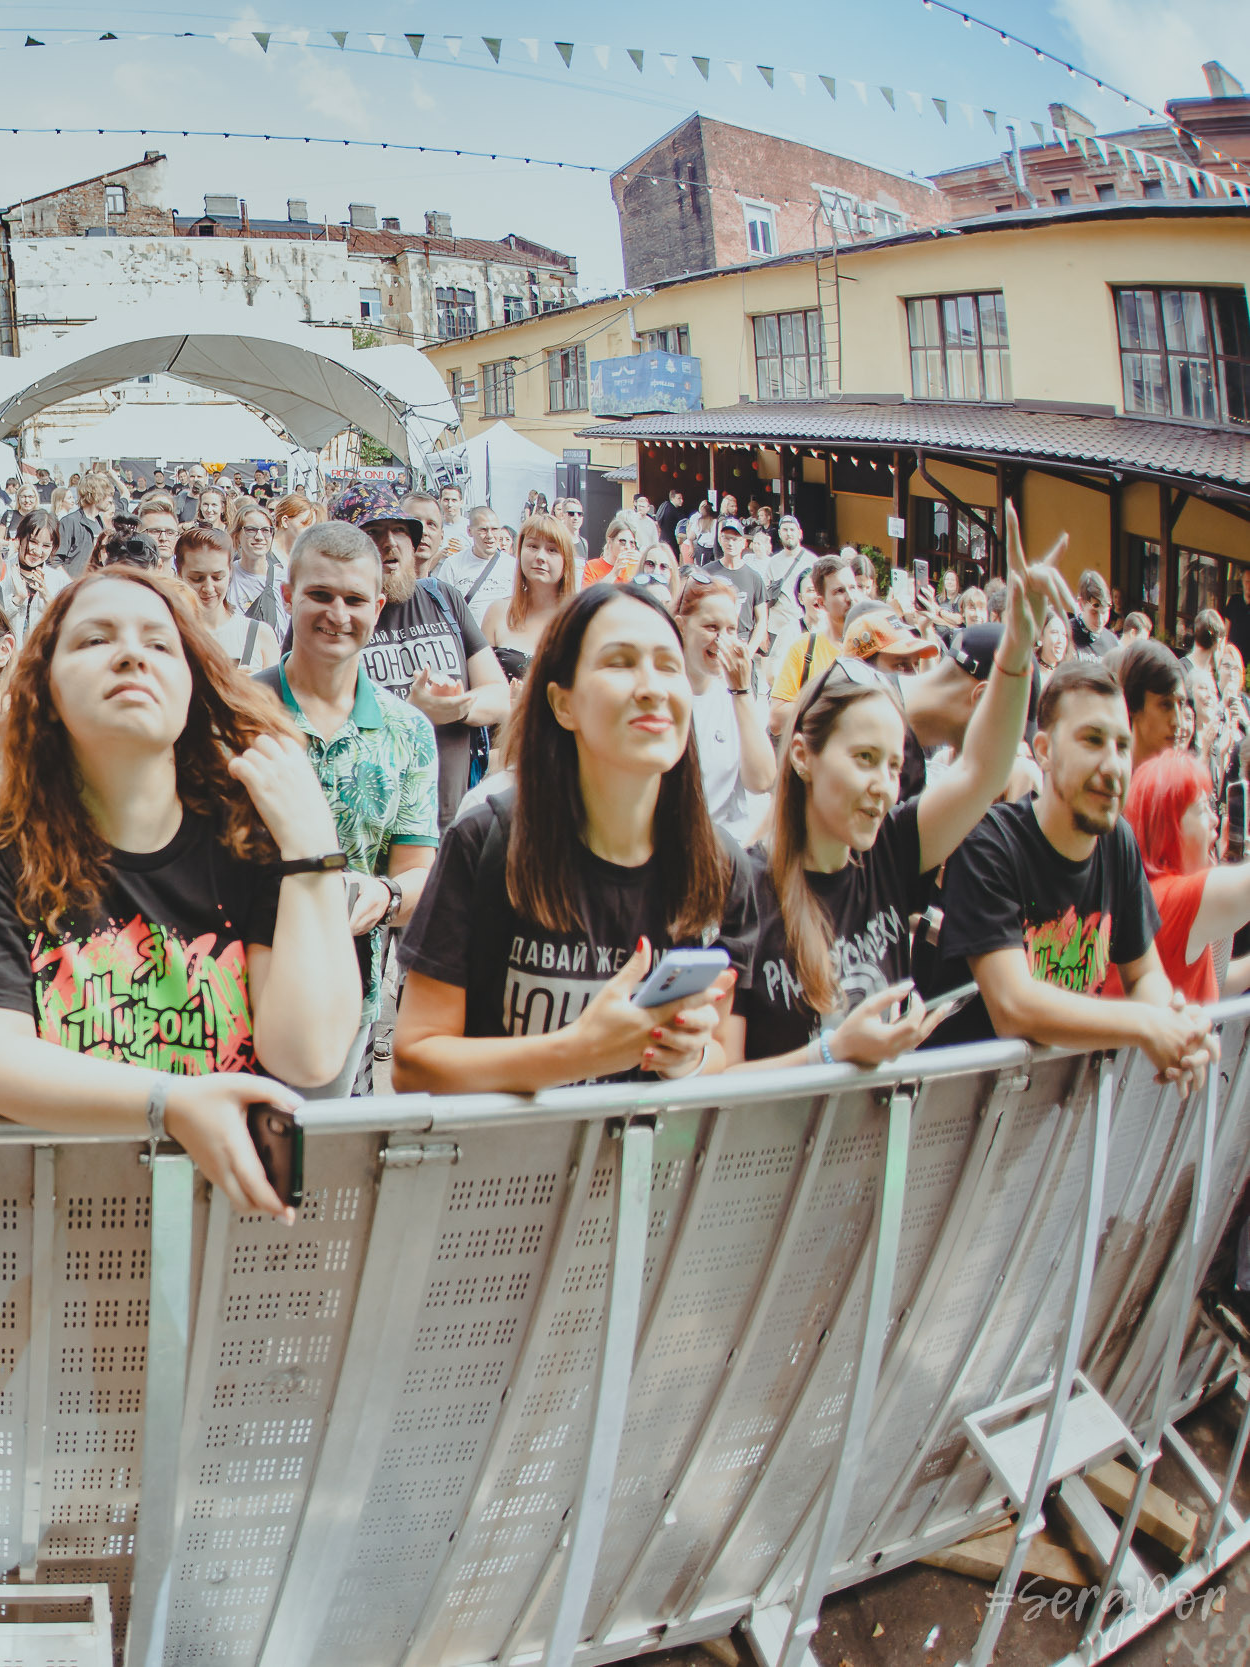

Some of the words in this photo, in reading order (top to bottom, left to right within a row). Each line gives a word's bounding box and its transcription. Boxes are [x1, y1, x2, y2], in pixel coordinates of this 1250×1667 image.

[331, 469, 361, 479] ROCK
[364, 470, 384, 480] ON!
[368, 629, 389, 645] ВАЙ
[391, 628, 407, 642] ЖЕ
[409, 621, 451, 638] ВМЕСТЕ
[363, 640, 457, 682] ЮНОСТЬ
[509, 936, 588, 972] ДАВАЙ
